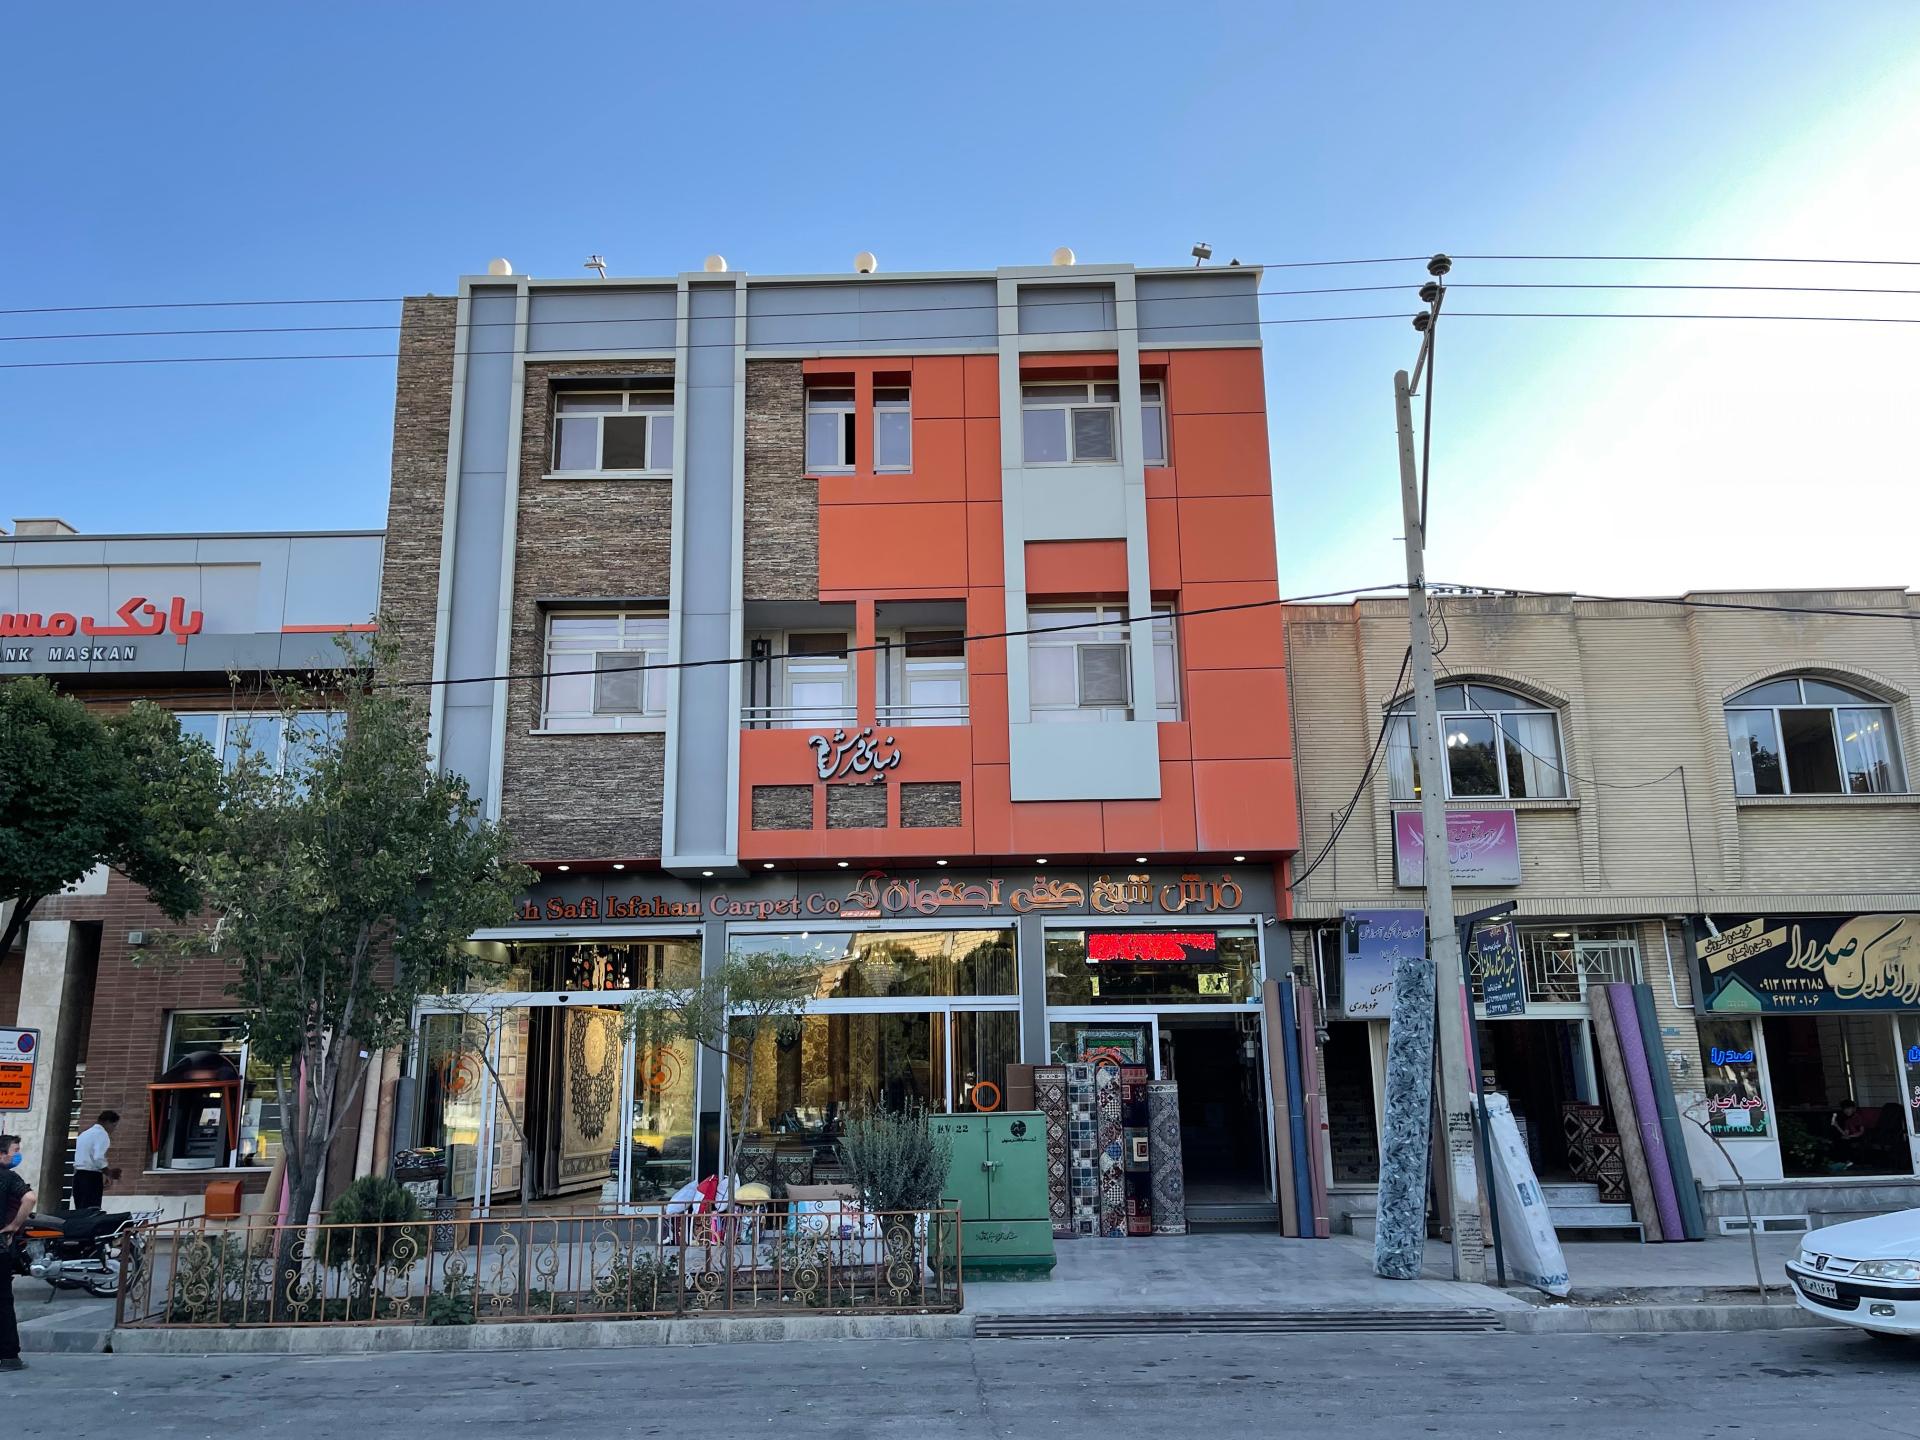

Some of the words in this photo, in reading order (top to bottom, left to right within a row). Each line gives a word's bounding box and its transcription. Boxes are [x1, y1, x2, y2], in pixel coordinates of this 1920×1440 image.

[0, 613, 76, 636] مس
[80, 597, 204, 645] بانک
[0, 648, 31, 661] NK
[49, 646, 137, 661] MASKAN
[853, 735, 902, 781] دنیای
[547, 896, 600, 919] Safi
[605, 895, 704, 918] Isfahan
[709, 893, 801, 920] Carpet
[806, 892, 841, 914] Co
[881, 878, 1004, 915] اصفهان
[1009, 874, 1085, 913] صفی
[1090, 874, 1154, 913] شیخ
[1160, 873, 1243, 912] فرش
[1785, 924, 1859, 972] صدرا
[1349, 998, 1379, 1012] خودباوری
[1711, 1047, 1754, 1066] صدرا
[1706, 1093, 1737, 1113] اجاره
[1740, 1095, 1768, 1112] رهن
